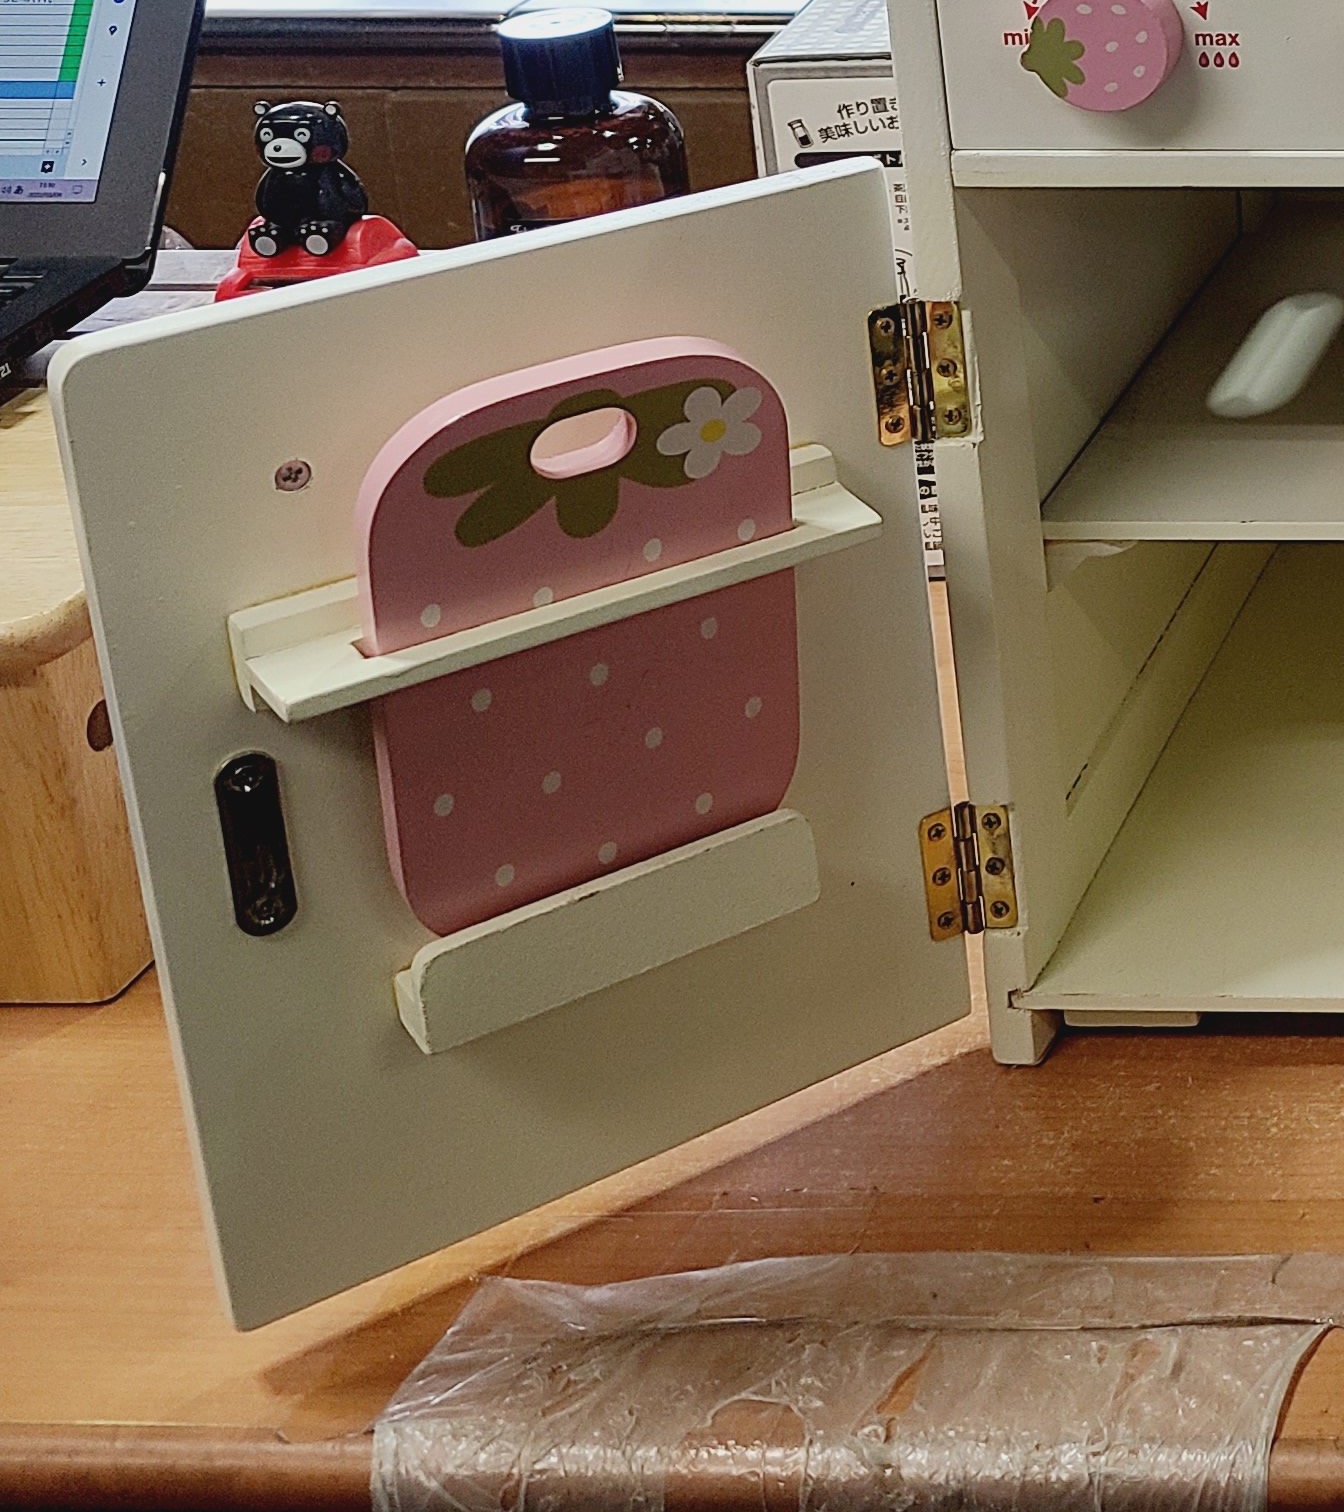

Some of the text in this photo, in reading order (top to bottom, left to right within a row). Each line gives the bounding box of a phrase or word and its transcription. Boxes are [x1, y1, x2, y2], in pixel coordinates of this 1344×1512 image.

[1003, 28, 1030, 45] mi
[1194, 32, 1240, 47] max
[817, 115, 900, 144] 美味しいお
